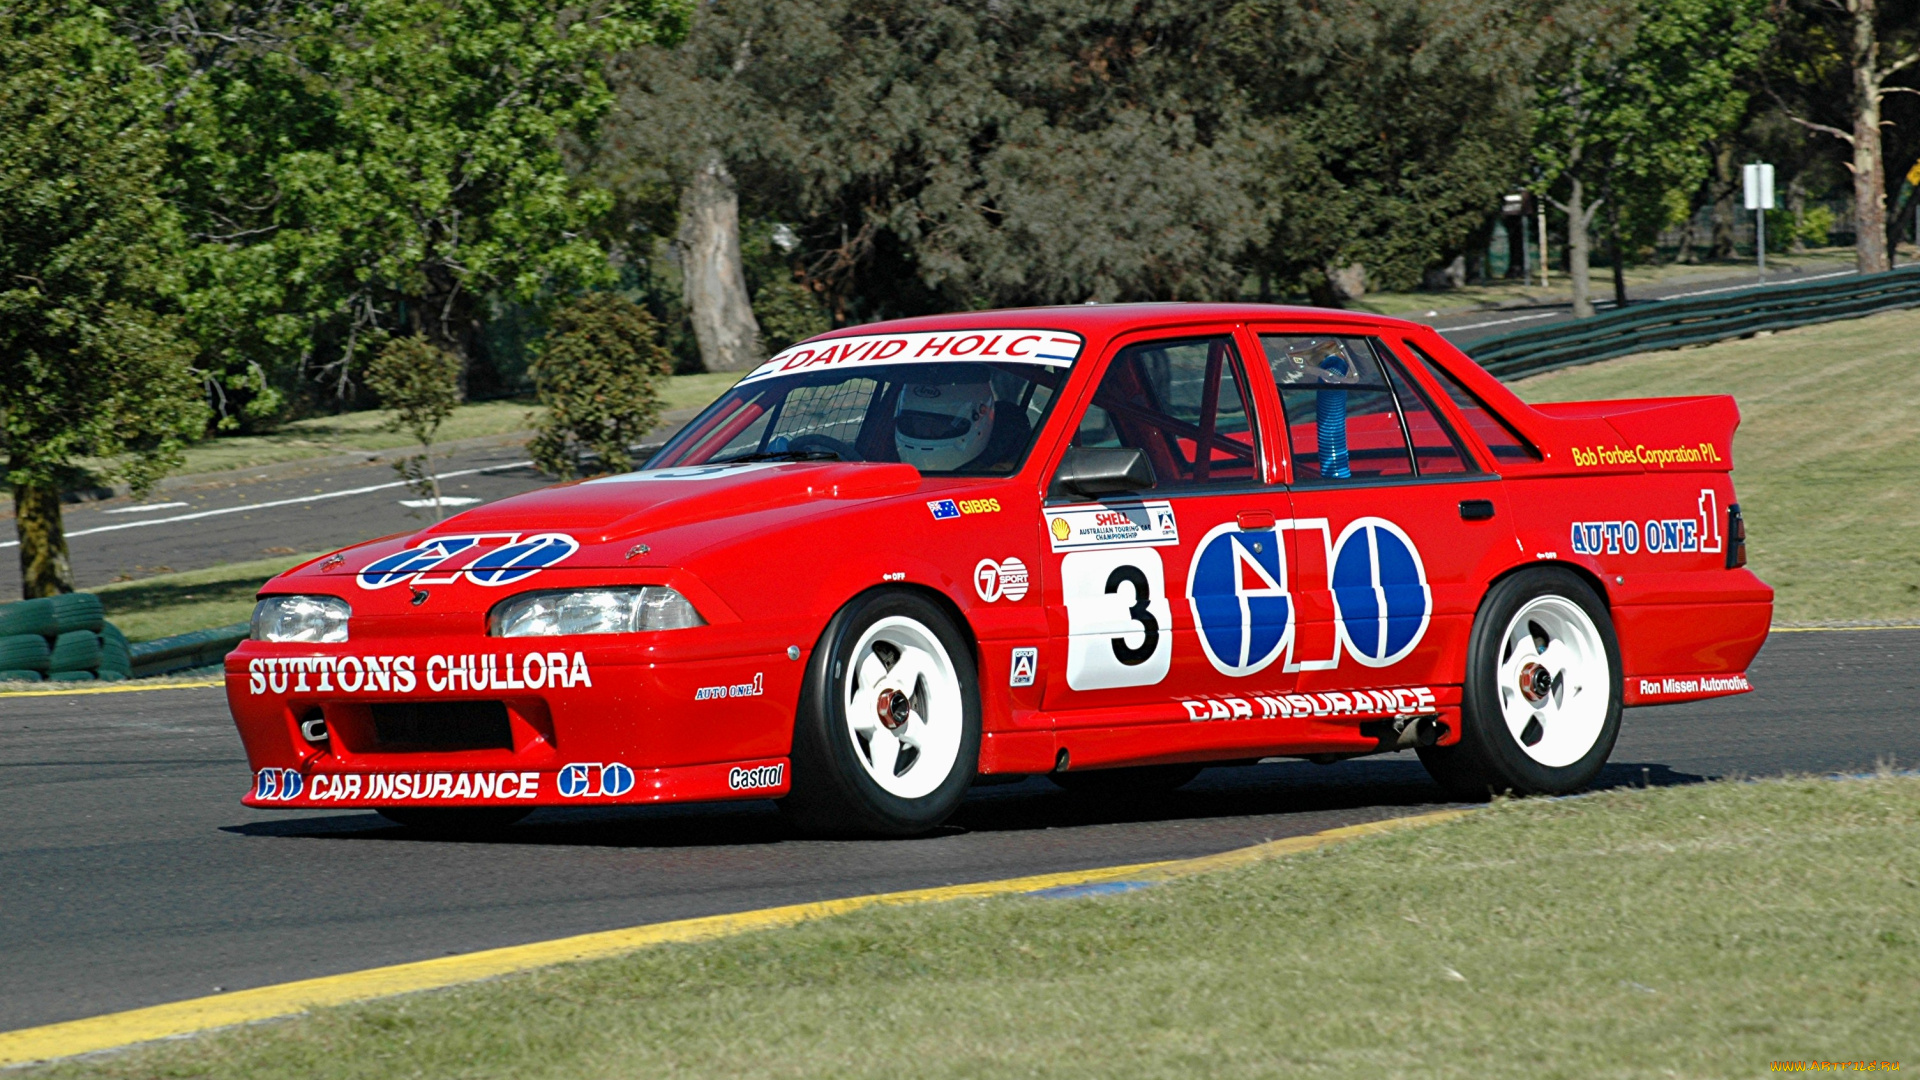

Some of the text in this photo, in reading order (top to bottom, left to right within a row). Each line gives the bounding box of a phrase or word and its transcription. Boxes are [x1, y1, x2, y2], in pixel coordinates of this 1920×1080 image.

[780, 335, 1042, 371] DAVID HOLC
[1571, 443, 1721, 468] Bob Forbes Corporation P/L
[959, 498, 1001, 515] GIBBS
[1096, 512, 1130, 526] SHELL
[1080, 527, 1114, 536] AUSTRALIAN
[1114, 525, 1140, 534] TOURING
[1571, 489, 1722, 555] AUTO ONE 1
[1096, 532, 1138, 541] CHAMPIONSHIP
[892, 572, 905, 580] OFF
[999, 574, 1029, 584] SPORT
[1104, 564, 1160, 666] 3
[249, 652, 592, 695] SUTTONS CHULLORA
[1014, 657, 1032, 676] A
[695, 672, 763, 700] AUTO ONE 1
[1640, 676, 1748, 695] Ron Missen Automotive
[1182, 687, 1436, 722] CAR INSURANCE
[309, 774, 362, 801] CAR
[364, 772, 540, 799] INSURANCE
[729, 763, 784, 790] Castrol
